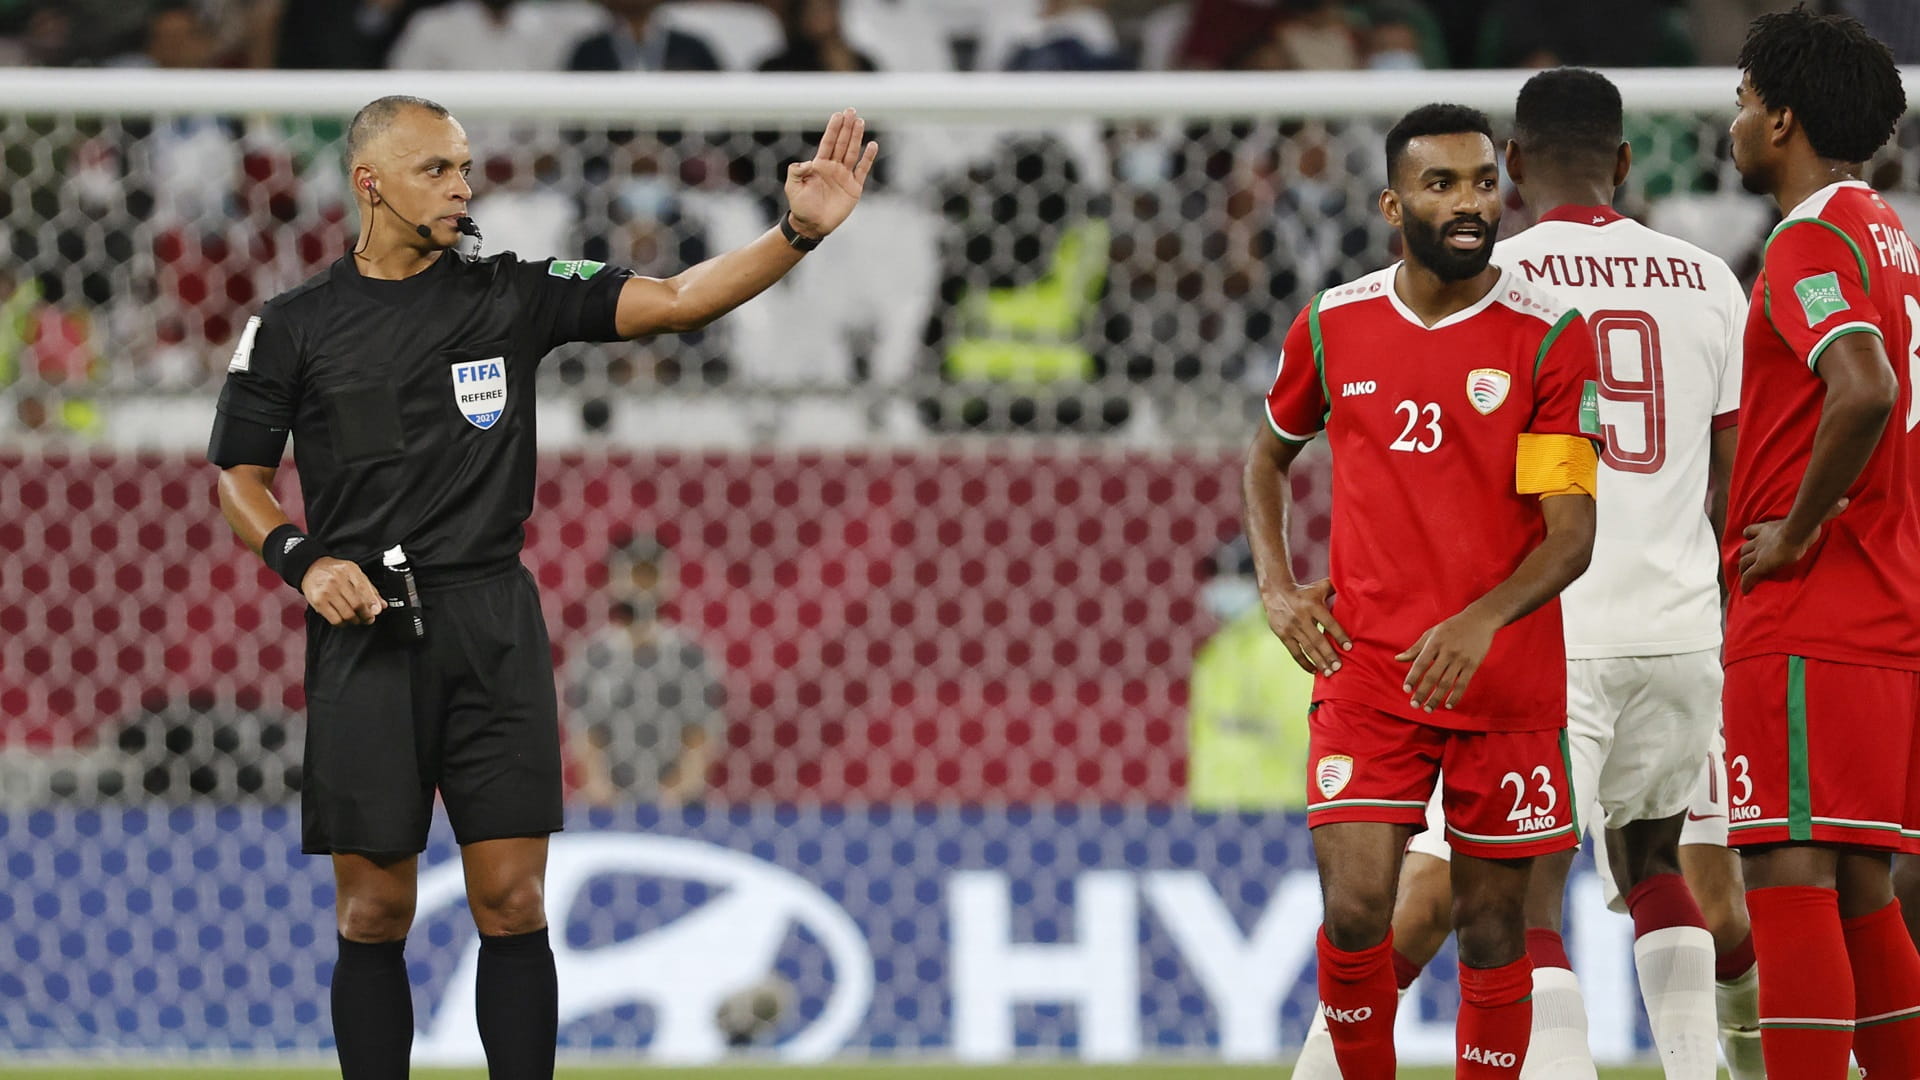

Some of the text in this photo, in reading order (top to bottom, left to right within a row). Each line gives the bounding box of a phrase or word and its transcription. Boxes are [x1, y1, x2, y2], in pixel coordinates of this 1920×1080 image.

[1519, 255, 1706, 291] MUNTARI
[457, 363, 501, 383] FIFA
[461, 389, 503, 403] REFEREE
[1342, 380, 1377, 397] JAKO
[1588, 310, 1666, 474] 9
[475, 413, 495, 424] 2021
[1389, 399, 1443, 454] 23
[1500, 765, 1557, 822] 23
[1516, 815, 1556, 833] JAKO
[1462, 1044, 1516, 1068] JAKO
